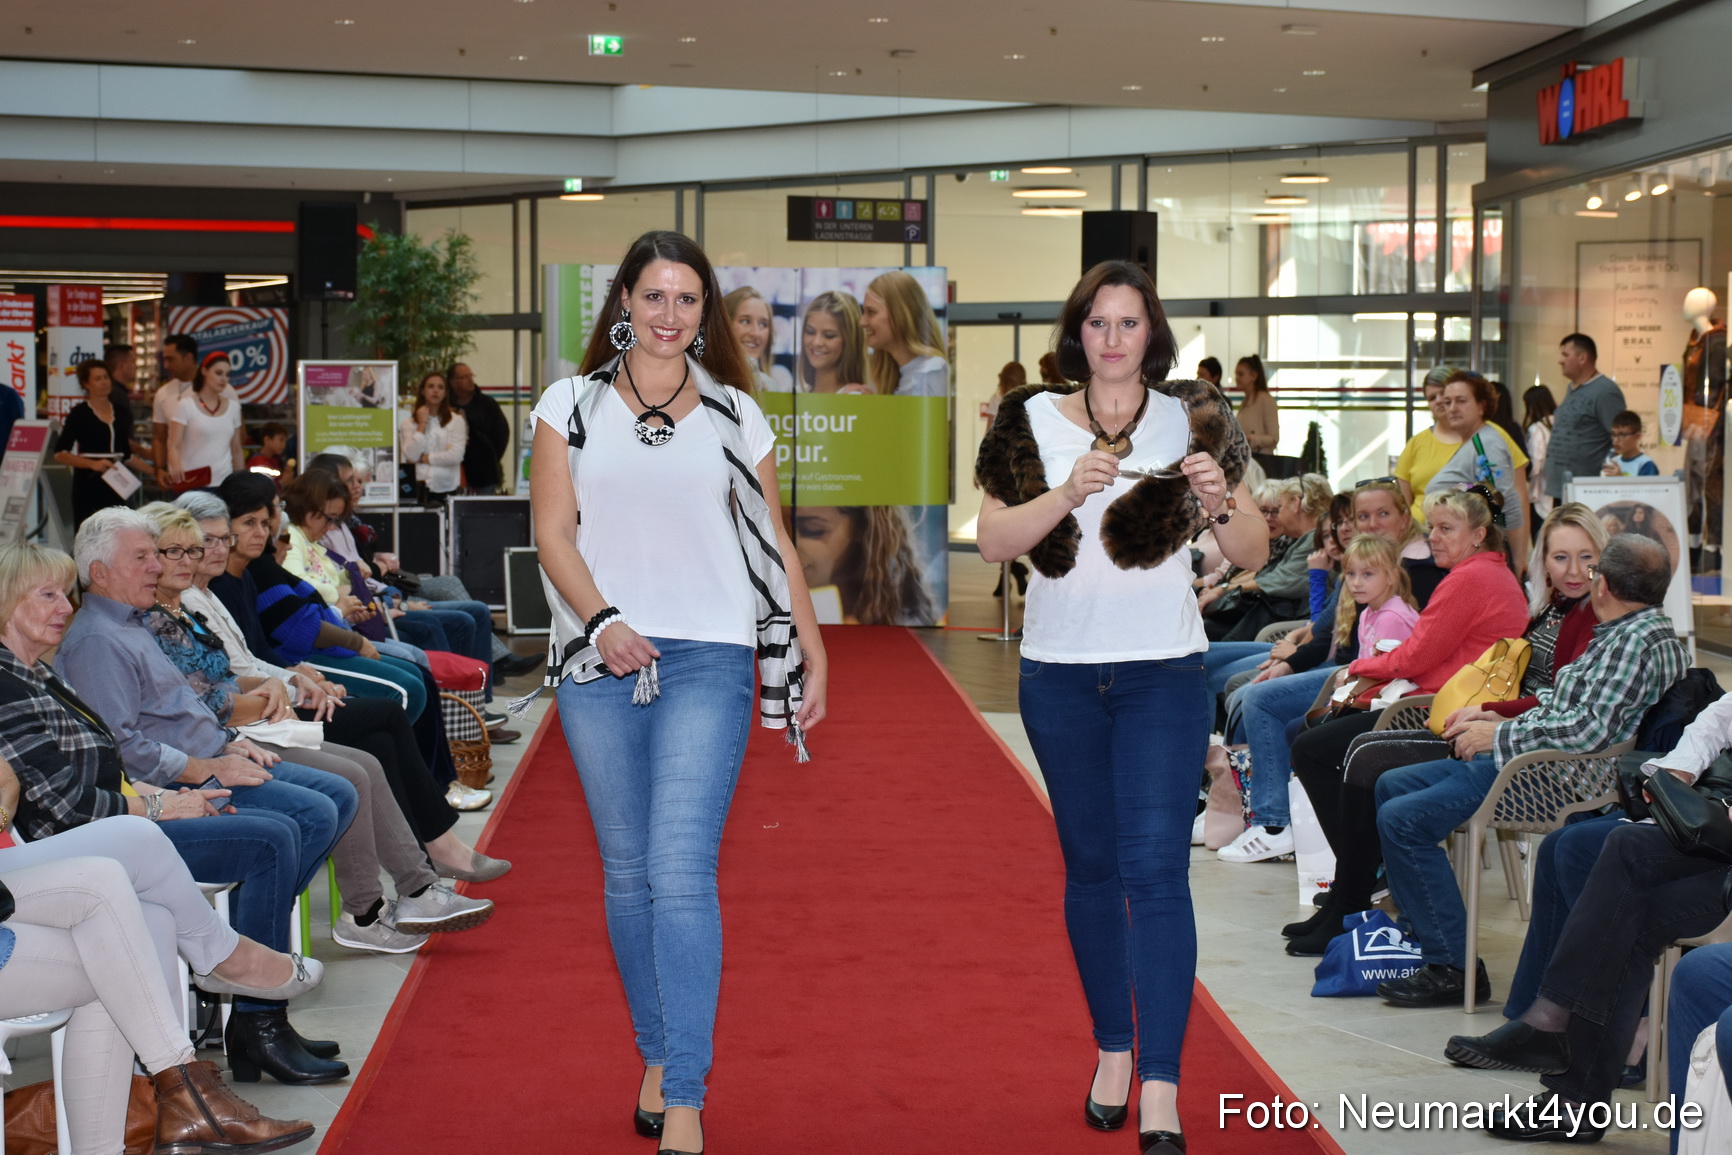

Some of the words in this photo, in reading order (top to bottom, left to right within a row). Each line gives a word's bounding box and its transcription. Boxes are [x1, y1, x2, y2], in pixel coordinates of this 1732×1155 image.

[7, 340, 26, 397] arkt
[228, 344, 268, 371] 0%
[765, 411, 858, 438] ngtour
[775, 444, 829, 468] pur.
